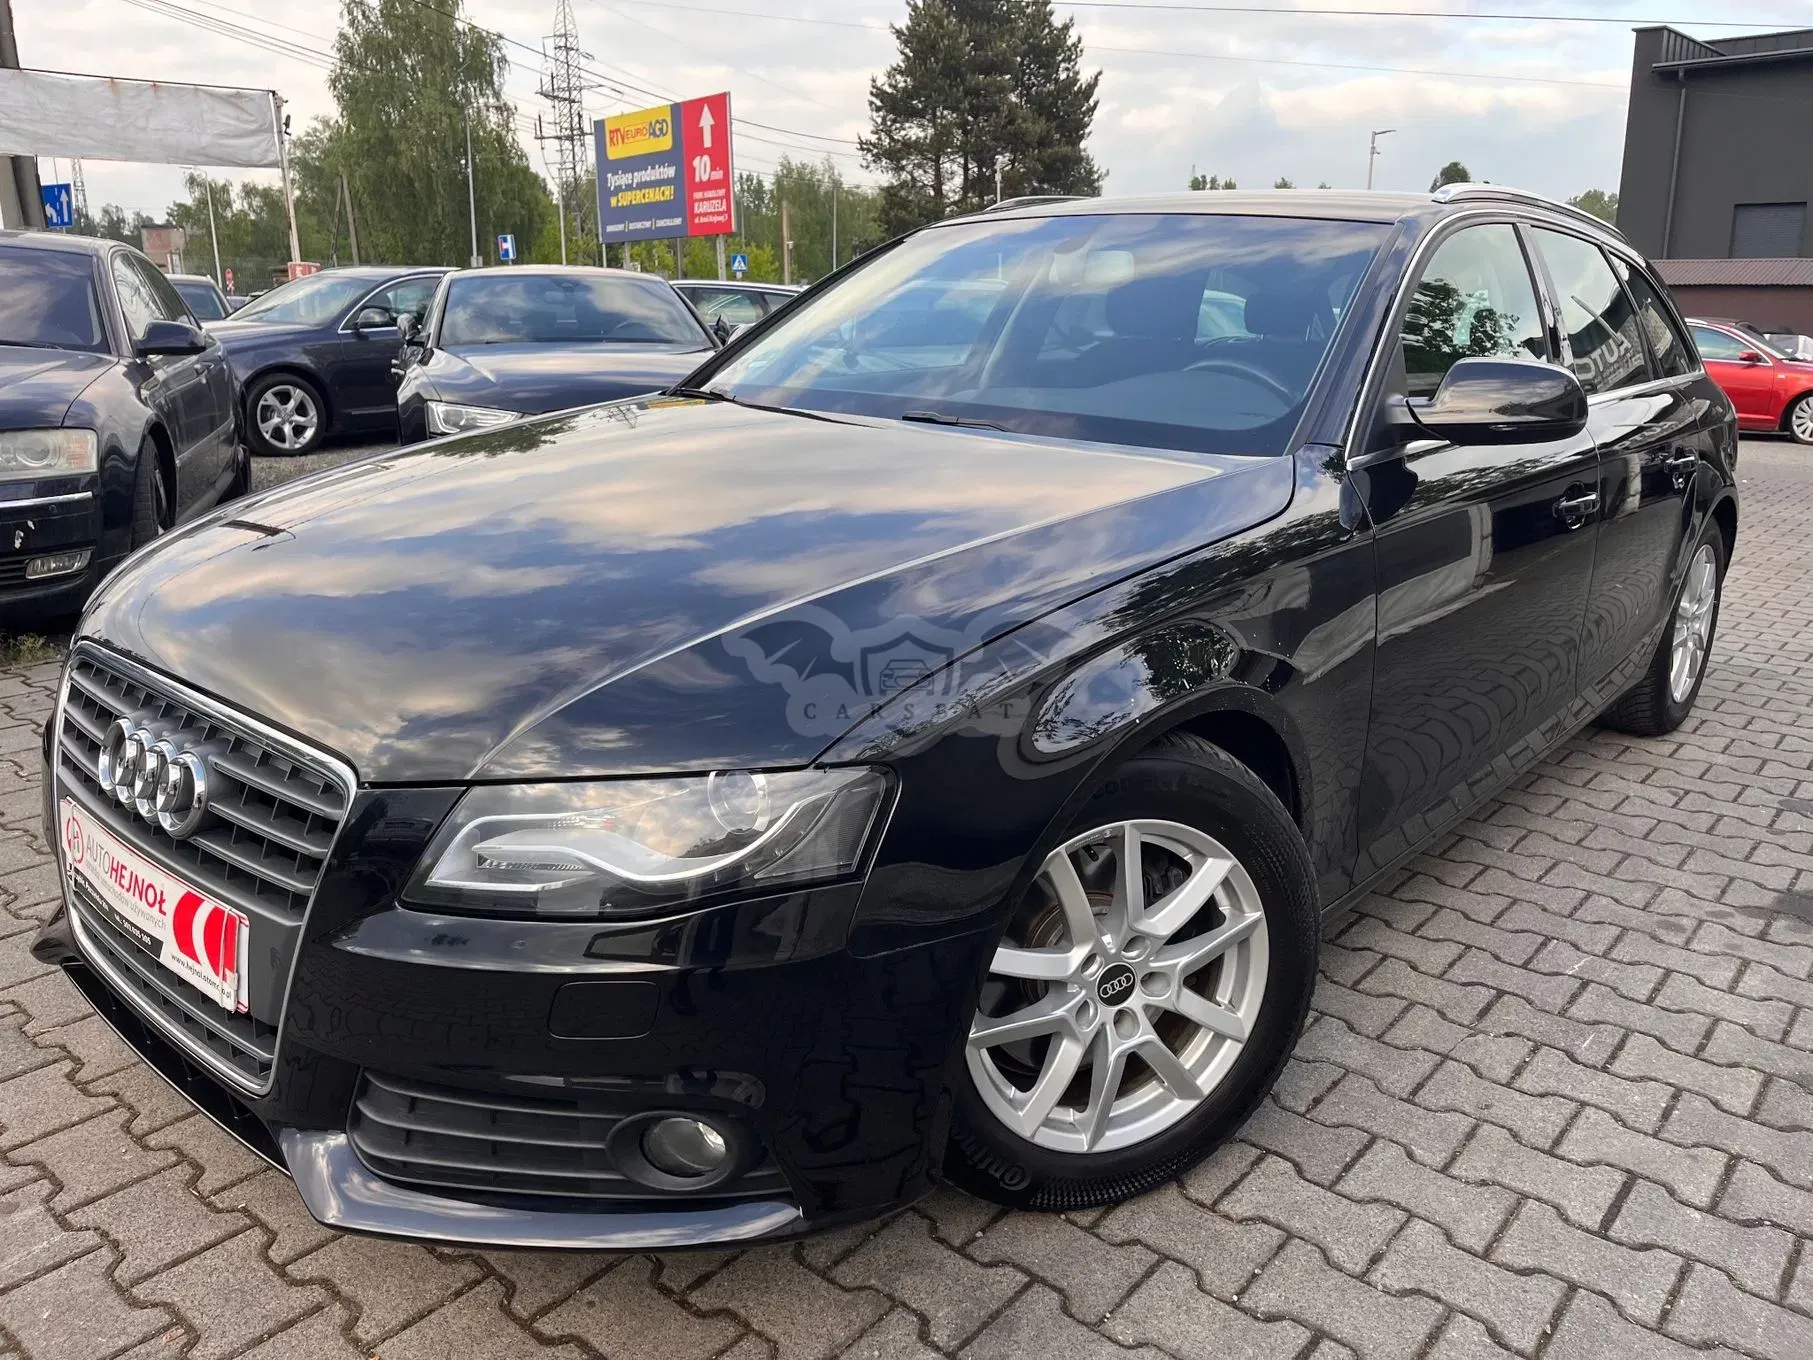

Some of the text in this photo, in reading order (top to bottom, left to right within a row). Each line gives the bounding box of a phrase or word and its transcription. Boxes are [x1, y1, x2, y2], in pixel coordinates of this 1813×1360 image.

[607, 163, 676, 191] Tysiące produktów
[692, 154, 711, 183] 10
[610, 185, 674, 208] w SUPERCENACH!
